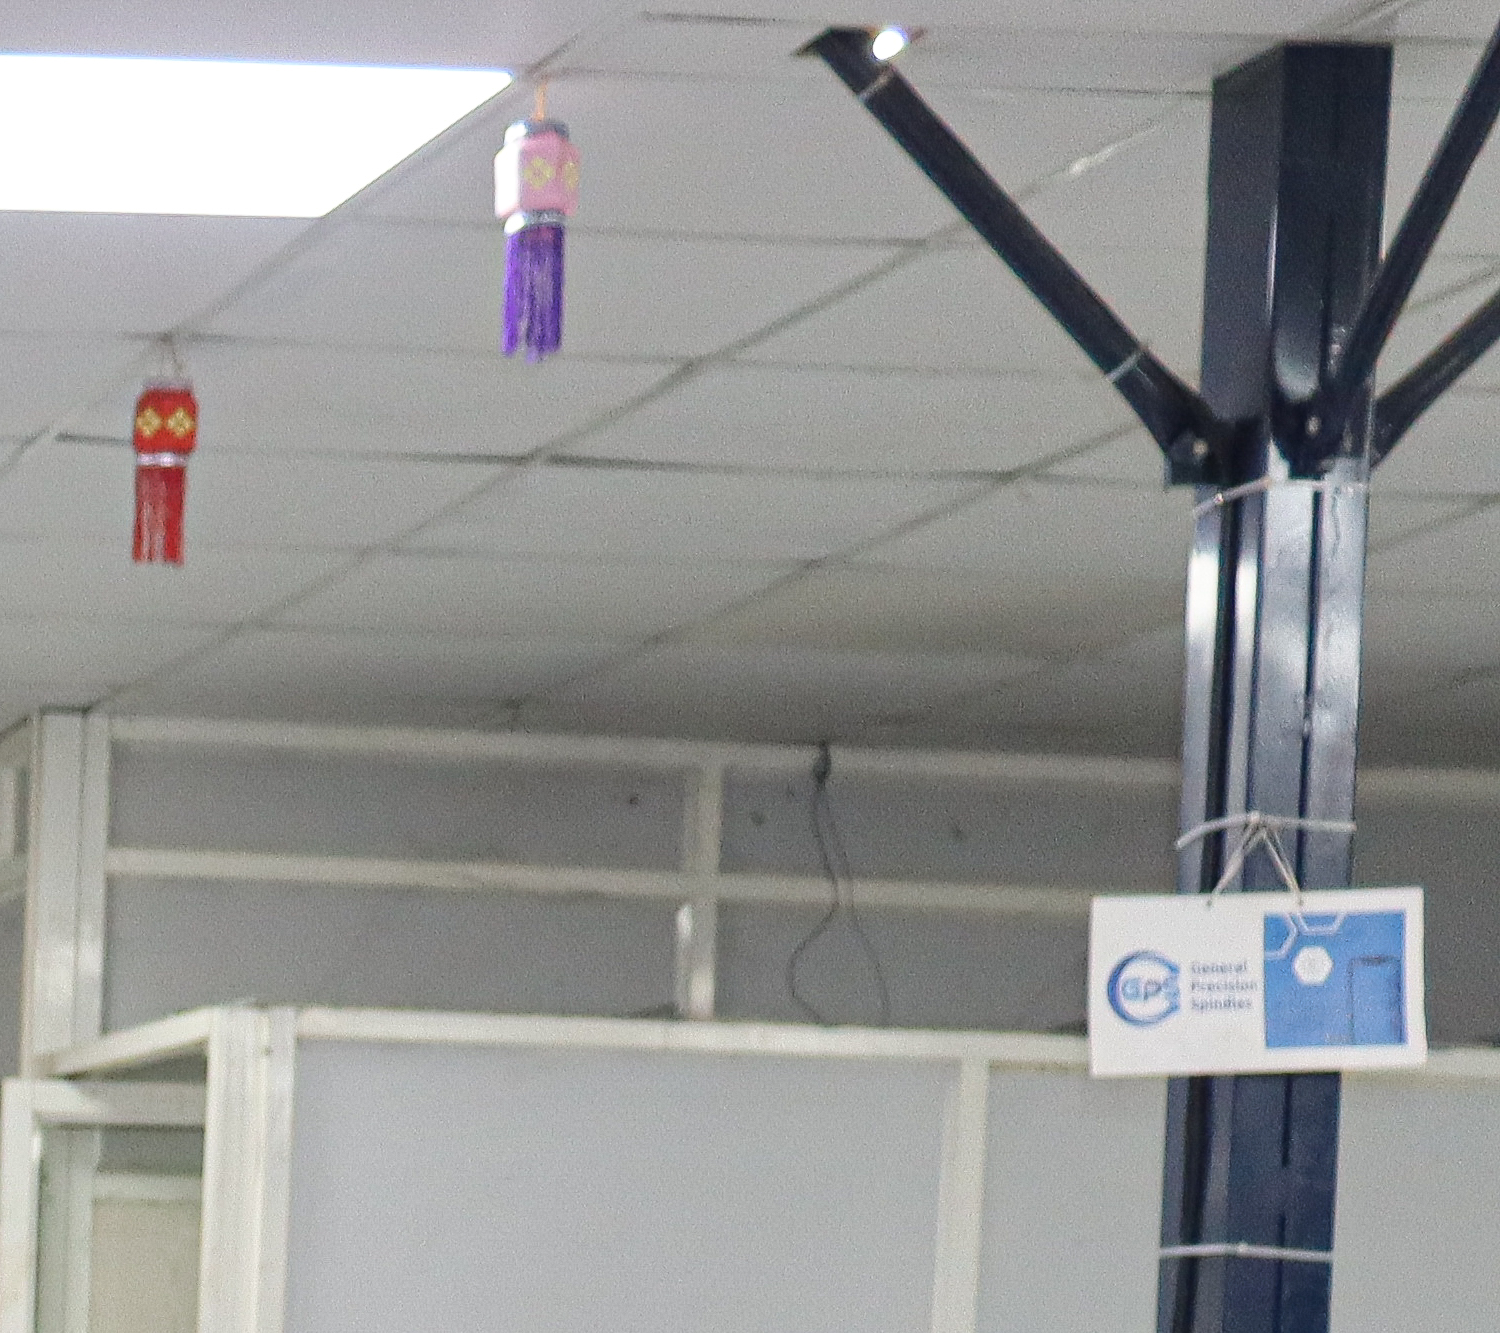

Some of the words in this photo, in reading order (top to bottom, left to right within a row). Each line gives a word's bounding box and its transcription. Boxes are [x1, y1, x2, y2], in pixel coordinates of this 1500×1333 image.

[1190, 959, 1248, 974] General
[1190, 978, 1259, 993] Precision
[1190, 999, 1254, 1013] Spindles
